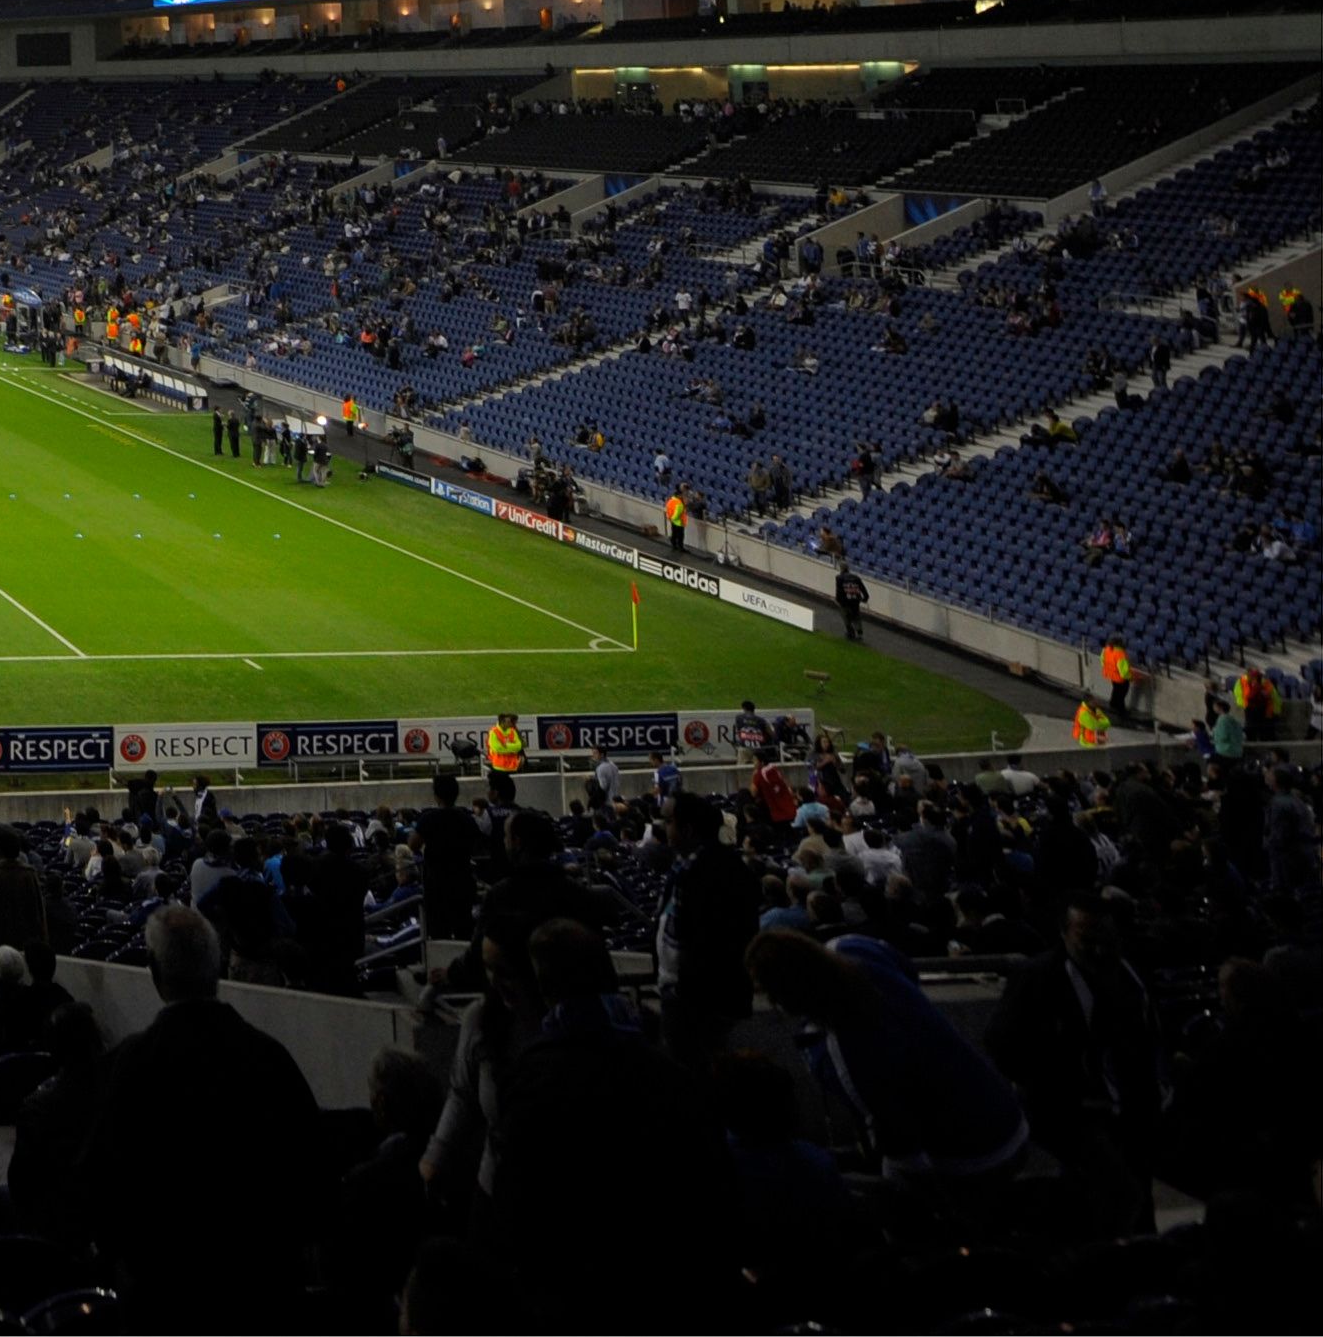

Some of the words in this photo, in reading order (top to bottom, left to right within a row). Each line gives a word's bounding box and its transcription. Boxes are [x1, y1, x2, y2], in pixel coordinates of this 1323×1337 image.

[509, 506, 557, 538] UniCredit
[575, 532, 634, 564] MasterCard
[663, 564, 718, 596] adidas
[155, 736, 253, 757] RESPECT
[297, 732, 394, 756] RESPECT
[580, 724, 675, 747] RESPECT
[10, 739, 110, 761] RESPECT
